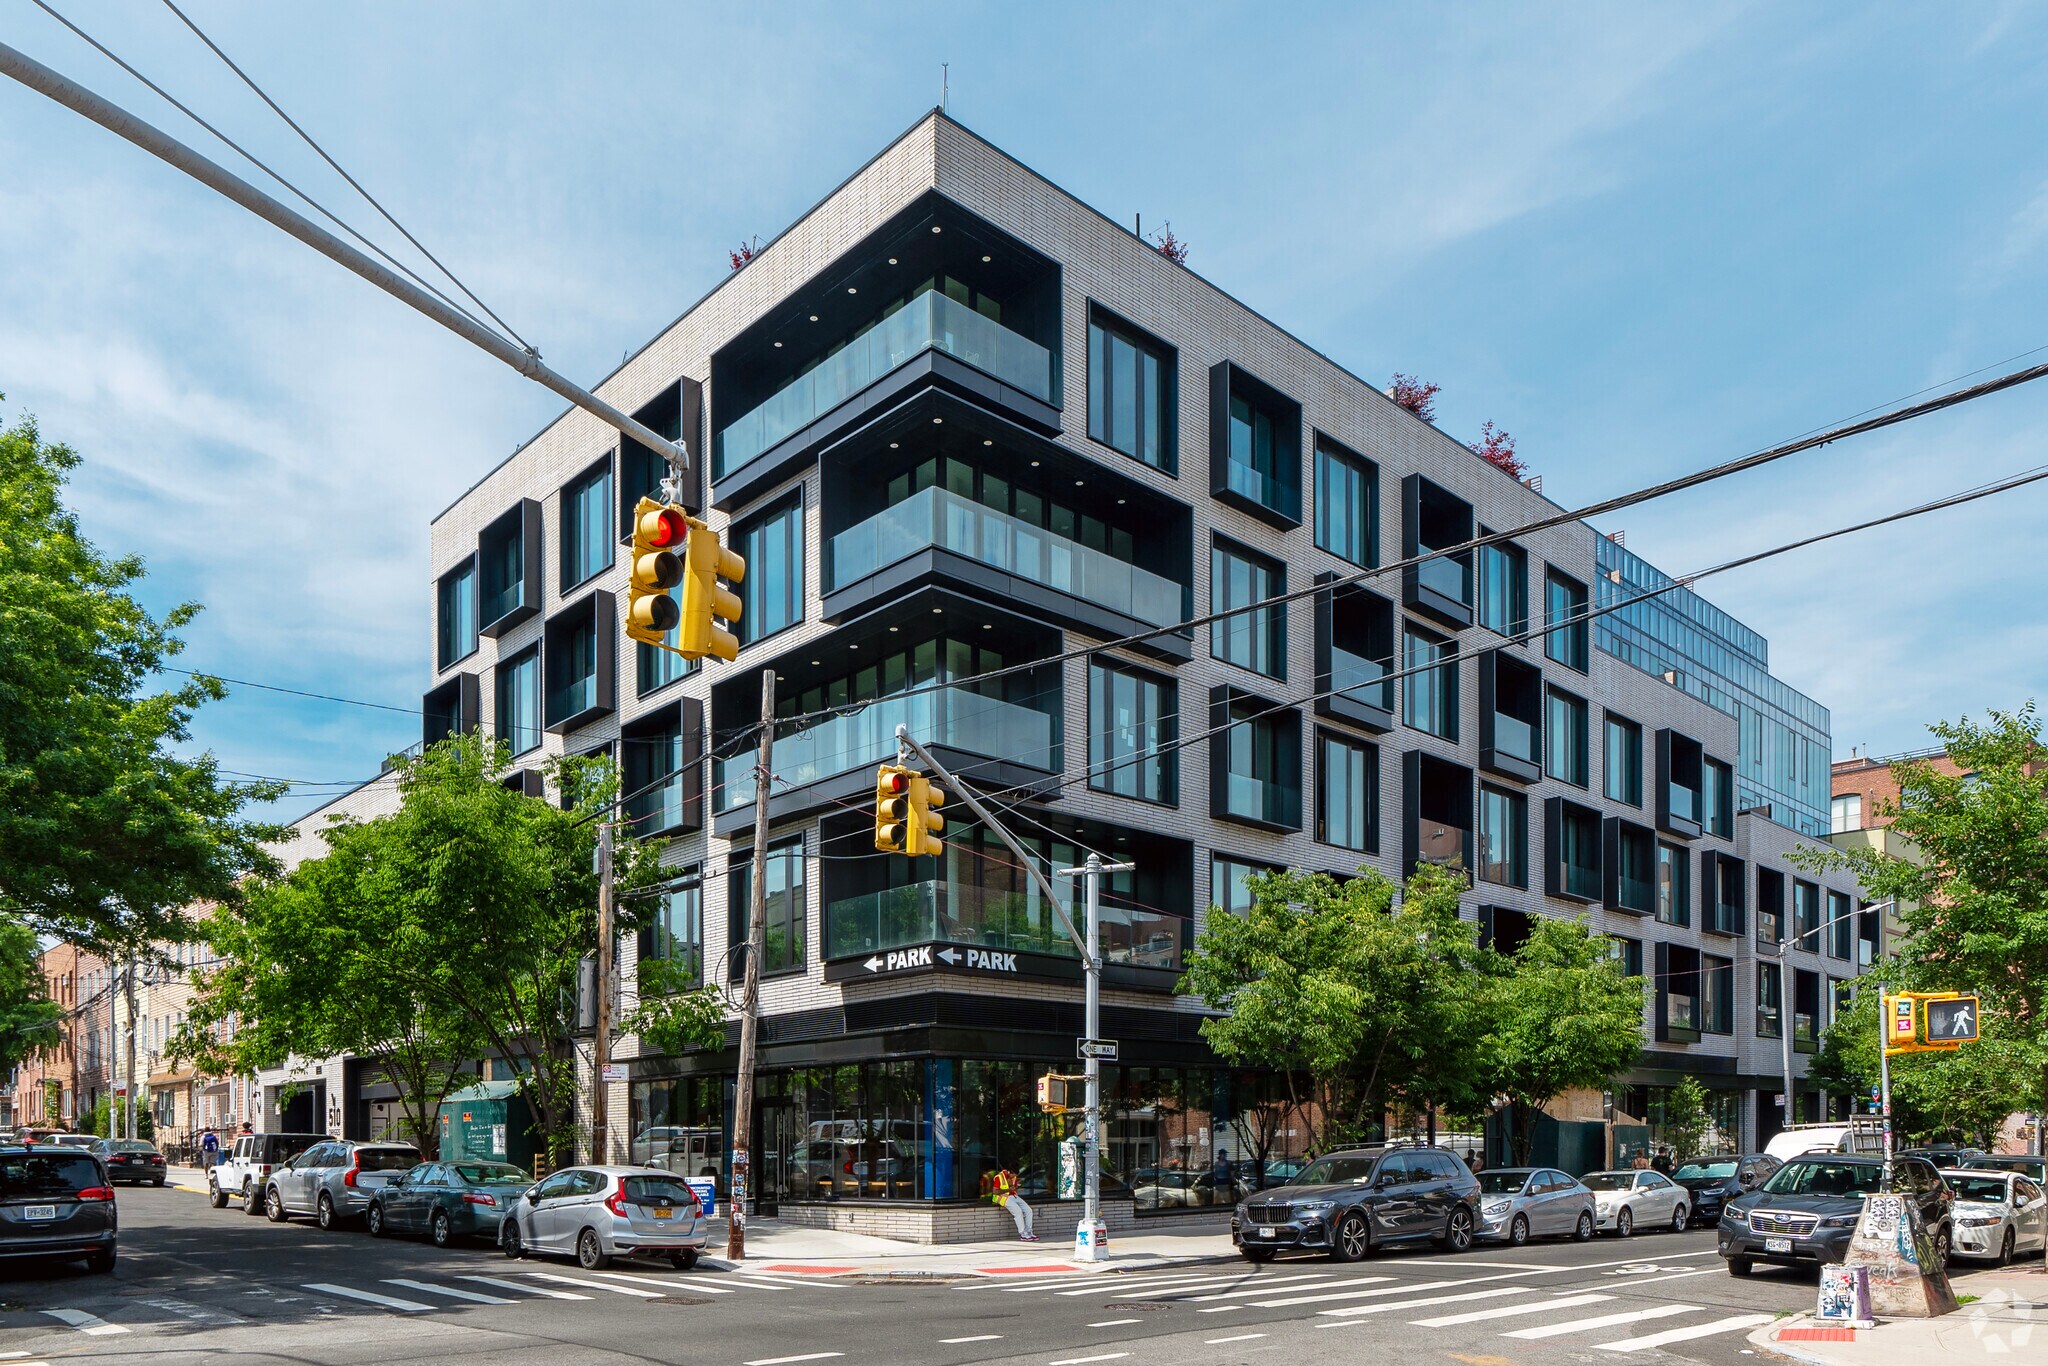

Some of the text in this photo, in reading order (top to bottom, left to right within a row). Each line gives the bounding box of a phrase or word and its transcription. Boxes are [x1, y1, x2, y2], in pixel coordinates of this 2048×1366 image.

[887, 946, 932, 970] PARK
[967, 949, 1017, 971] PARK
[328, 1108, 341, 1127] 510
